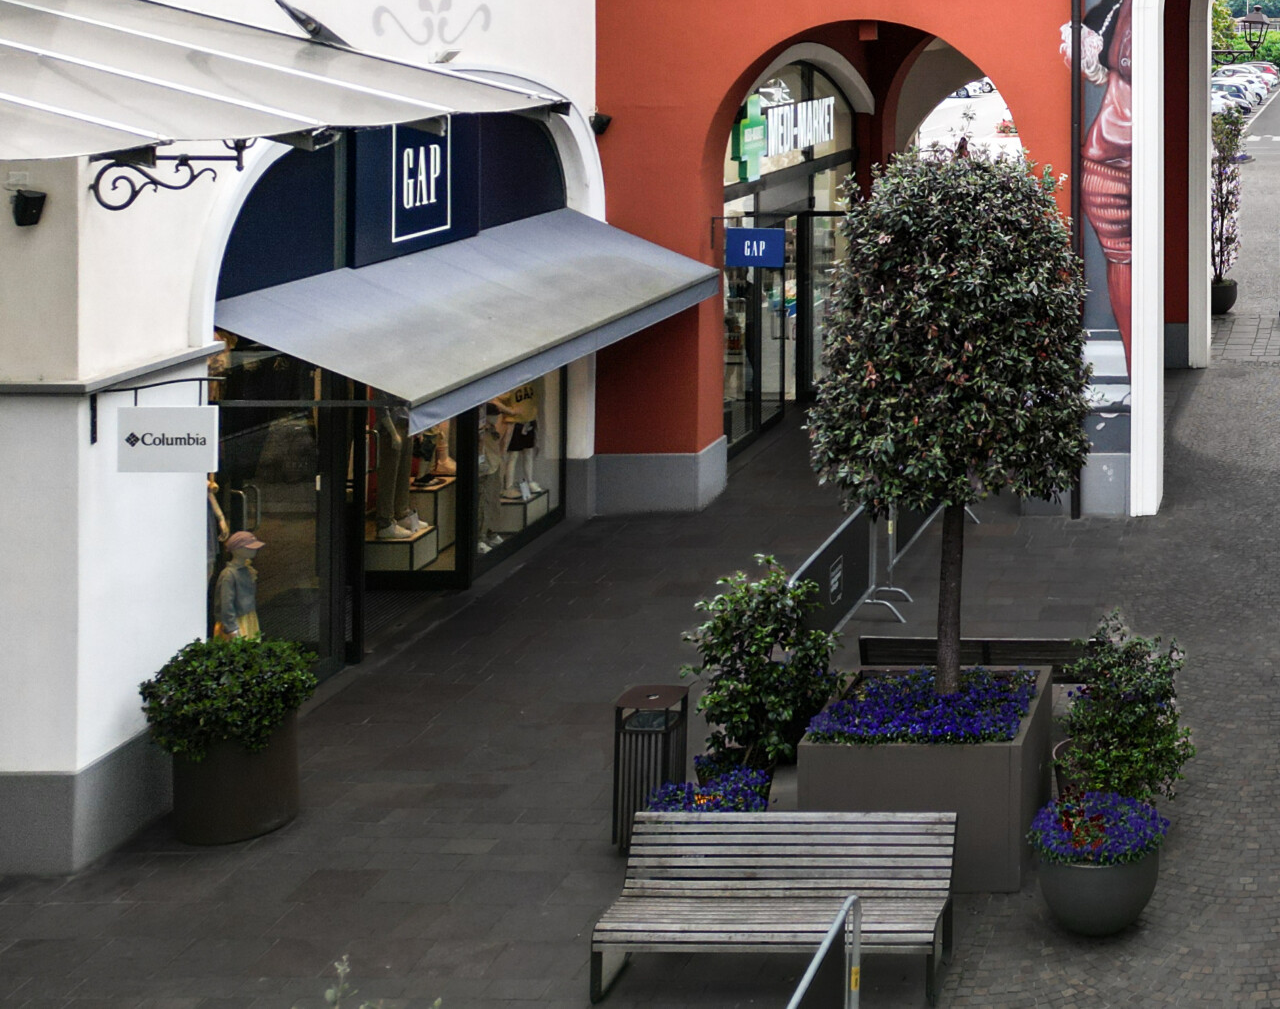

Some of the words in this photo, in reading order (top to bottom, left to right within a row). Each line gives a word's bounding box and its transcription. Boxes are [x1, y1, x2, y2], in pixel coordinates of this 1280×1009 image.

[767, 96, 835, 158] MEDI-MARKET
[403, 144, 441, 209] GAP
[744, 240, 766, 257] GAP
[141, 432, 206, 446] Columbia
